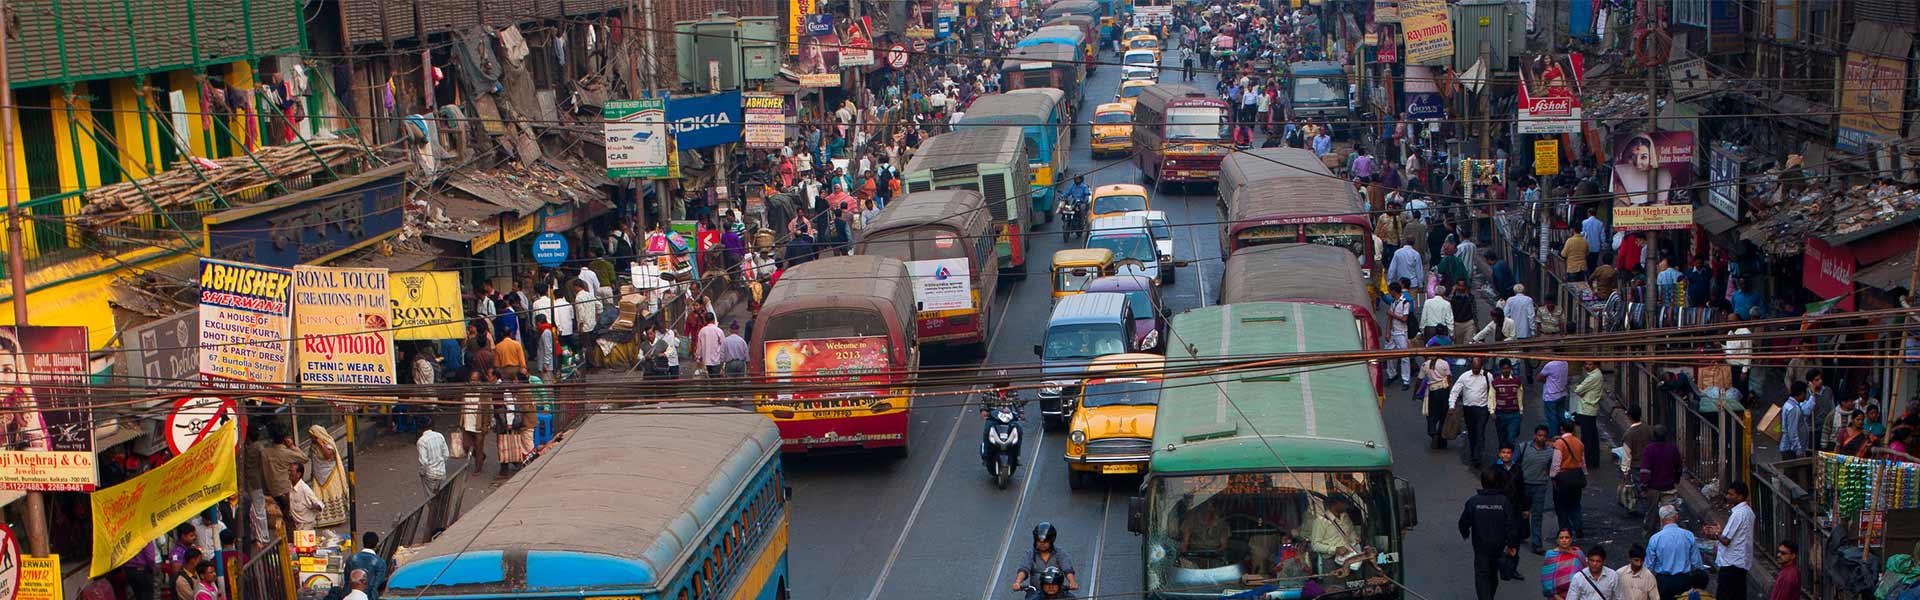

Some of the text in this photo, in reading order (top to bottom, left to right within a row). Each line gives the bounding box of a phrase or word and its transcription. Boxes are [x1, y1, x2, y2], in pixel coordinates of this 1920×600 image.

[1407, 22, 1448, 41] Raymond
[746, 97, 784, 109] ABHISHEK
[1408, 102, 1438, 114] CROWN
[1530, 99, 1568, 113] Ashok
[668, 111, 731, 134] NOKIA
[201, 263, 292, 302] ABHISHEK
[296, 270, 386, 290] ROYAL TOUCH
[201, 290, 285, 313] SHERWANI
[296, 291, 385, 309] CREATIONS (P) Ltd
[219, 311, 269, 326] A HOUSE OF
[203, 329, 229, 343] DHOTI
[230, 334, 247, 346] SET,
[205, 319, 283, 341] EXCLUSIVE KURTA,
[201, 341, 285, 363] SUIT & PARTY DRESS
[303, 330, 387, 361] Raymond
[825, 342, 859, 350] Welcome
[53, 353, 82, 369] Diamond
[222, 355, 253, 368] Burtolla
[254, 360, 278, 373] Street
[835, 351, 861, 360] 2013
[211, 363, 224, 374] 3rd
[307, 361, 385, 373] ETHNIC WEAR &
[302, 372, 391, 385] DRESS MATERIALS
[15, 453, 58, 470] Meghraj
[60, 453, 70, 466] &
[73, 454, 91, 467] Co.
[15, 466, 47, 475] Jewellers
